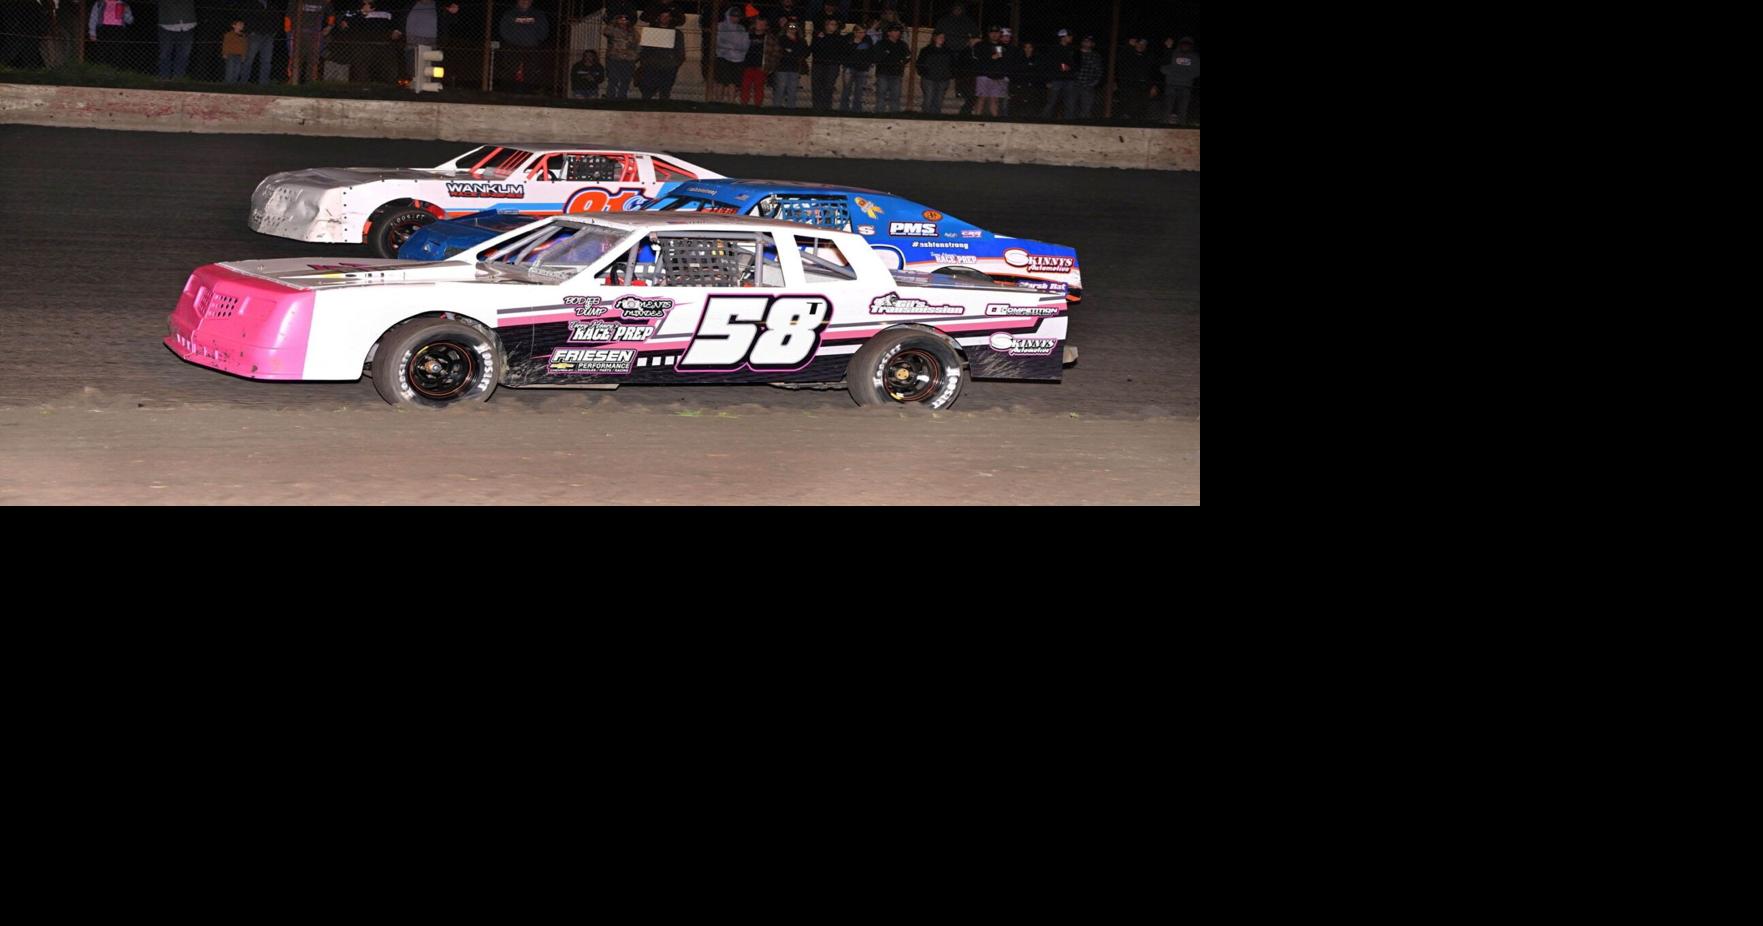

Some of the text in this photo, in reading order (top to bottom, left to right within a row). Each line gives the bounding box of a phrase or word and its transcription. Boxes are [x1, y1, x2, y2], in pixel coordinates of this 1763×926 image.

[448, 183, 523, 194] WANKUM
[890, 222, 936, 233] PMS
[1004, 249, 1073, 267] SKINNYS
[870, 304, 963, 313] Transmission
[613, 326, 654, 340] PREP
[551, 349, 633, 362] FRIESEN
